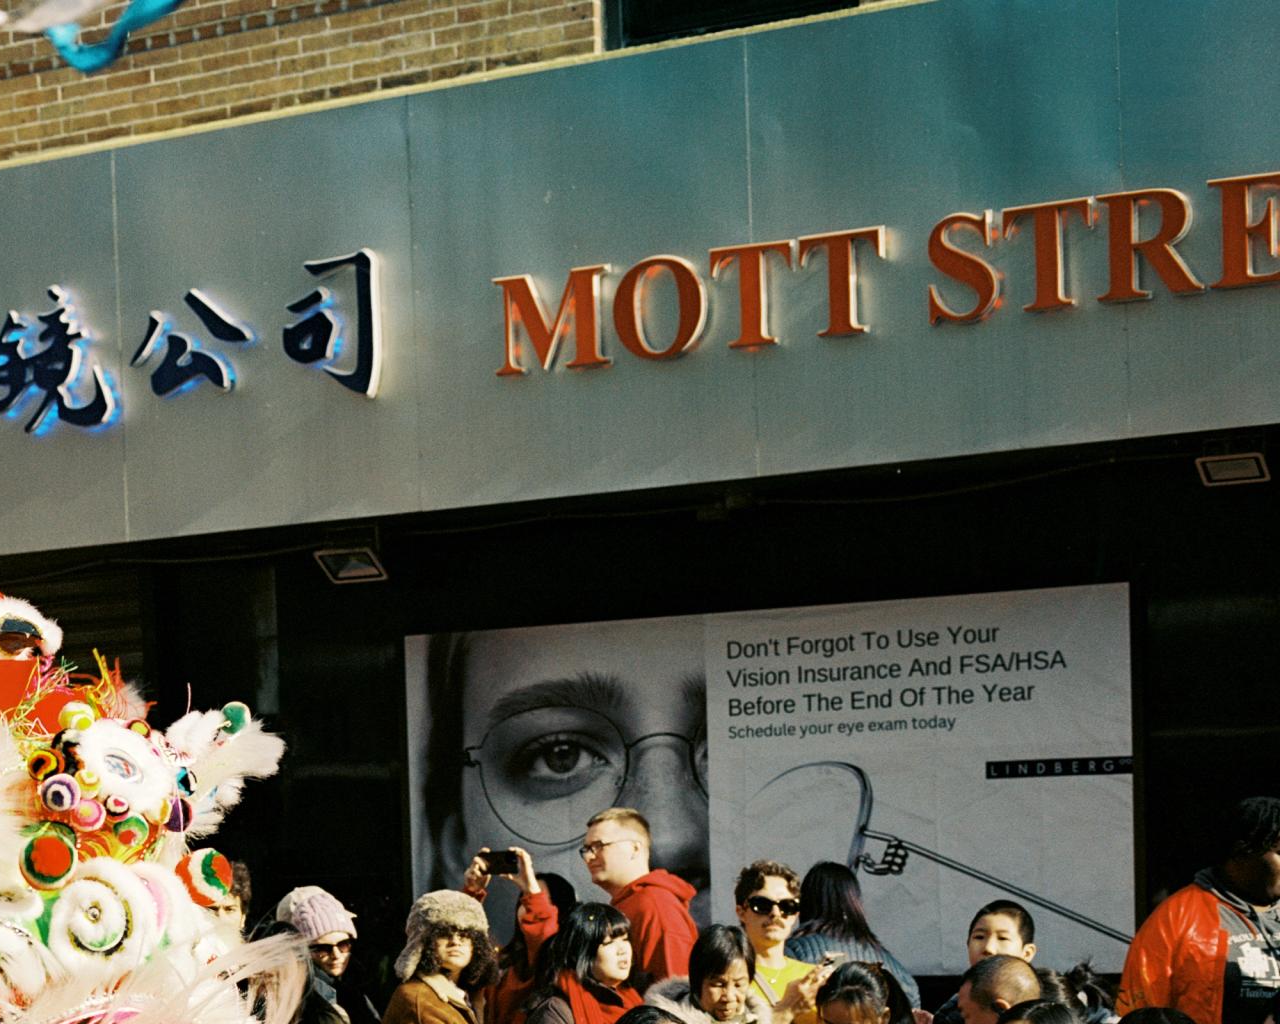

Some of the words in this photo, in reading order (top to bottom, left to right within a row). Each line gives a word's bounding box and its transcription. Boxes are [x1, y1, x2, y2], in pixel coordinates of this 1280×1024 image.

[492, 225, 888, 377] MOTT
[926, 171, 1280, 326] STRE
[726, 638, 780, 660] Don't
[786, 633, 855, 659] Forgot
[861, 631, 890, 650] To
[897, 629, 940, 649] Use
[947, 625, 1000, 645] Your
[726, 667, 790, 688] Vision
[797, 661, 902, 684] Insurance
[908, 656, 952, 677] And
[959, 650, 1067, 675] FSA/HSA
[728, 695, 796, 717] Before
[802, 692, 844, 712] The
[851, 688, 892, 711] End
[900, 686, 926, 708] Of
[932, 685, 975, 706] The
[982, 683, 1035, 703] Year
[728, 723, 796, 740] Schedule
[799, 721, 833, 739] your
[837, 720, 865, 736] eye
[867, 717, 908, 732] exam
[911, 715, 957, 732] today
[990, 759, 1115, 777] LINDBERG
